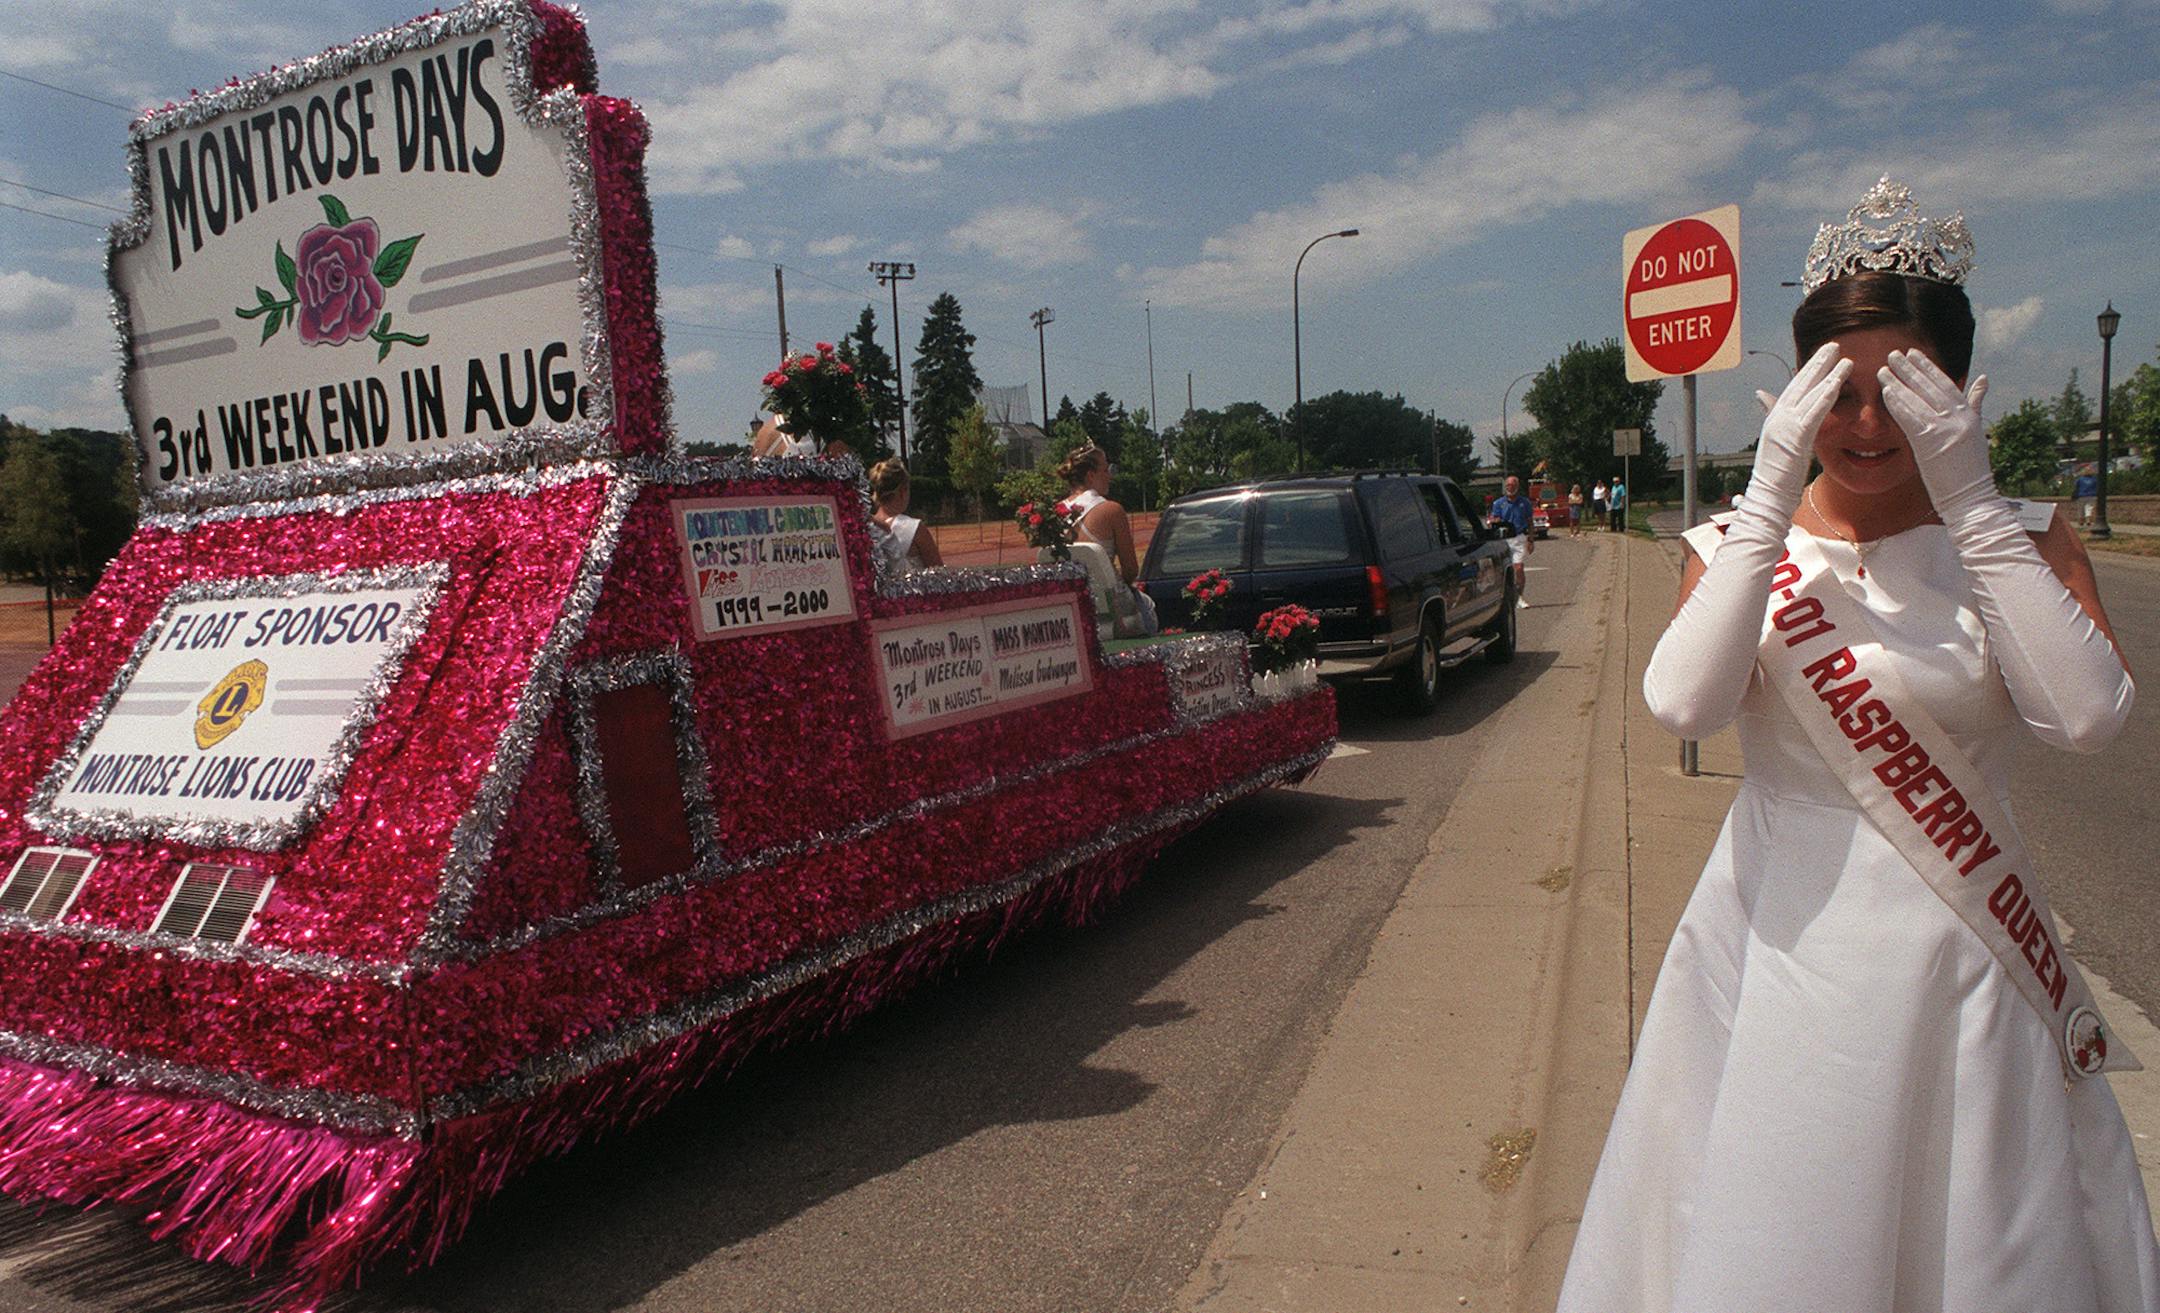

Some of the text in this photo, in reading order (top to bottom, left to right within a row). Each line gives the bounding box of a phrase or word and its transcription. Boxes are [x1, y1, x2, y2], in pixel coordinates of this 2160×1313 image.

[158, 39, 504, 271] MONTROSE DAYS
[1642, 245, 1717, 282] DO NOT
[1650, 315, 1712, 346] ENTER
[153, 409, 212, 481] 3rd
[218, 377, 389, 469] WEEKEND
[400, 365, 447, 442] IN
[692, 539, 767, 567] CRYSTAL
[160, 602, 402, 651] FLOAT SPONSOR
[992, 617, 1071, 651] MISS MONTROSE
[884, 631, 982, 667] Montrose Days
[893, 660, 983, 709] 3rd WEEKEND
[1000, 664, 1033, 691] Melissa
[928, 698, 941, 715] IN
[71, 754, 316, 802] MONTROSE LIONS CLUB
[1770, 548, 2069, 1012] 0-01 RASPBERRY QUEEN
